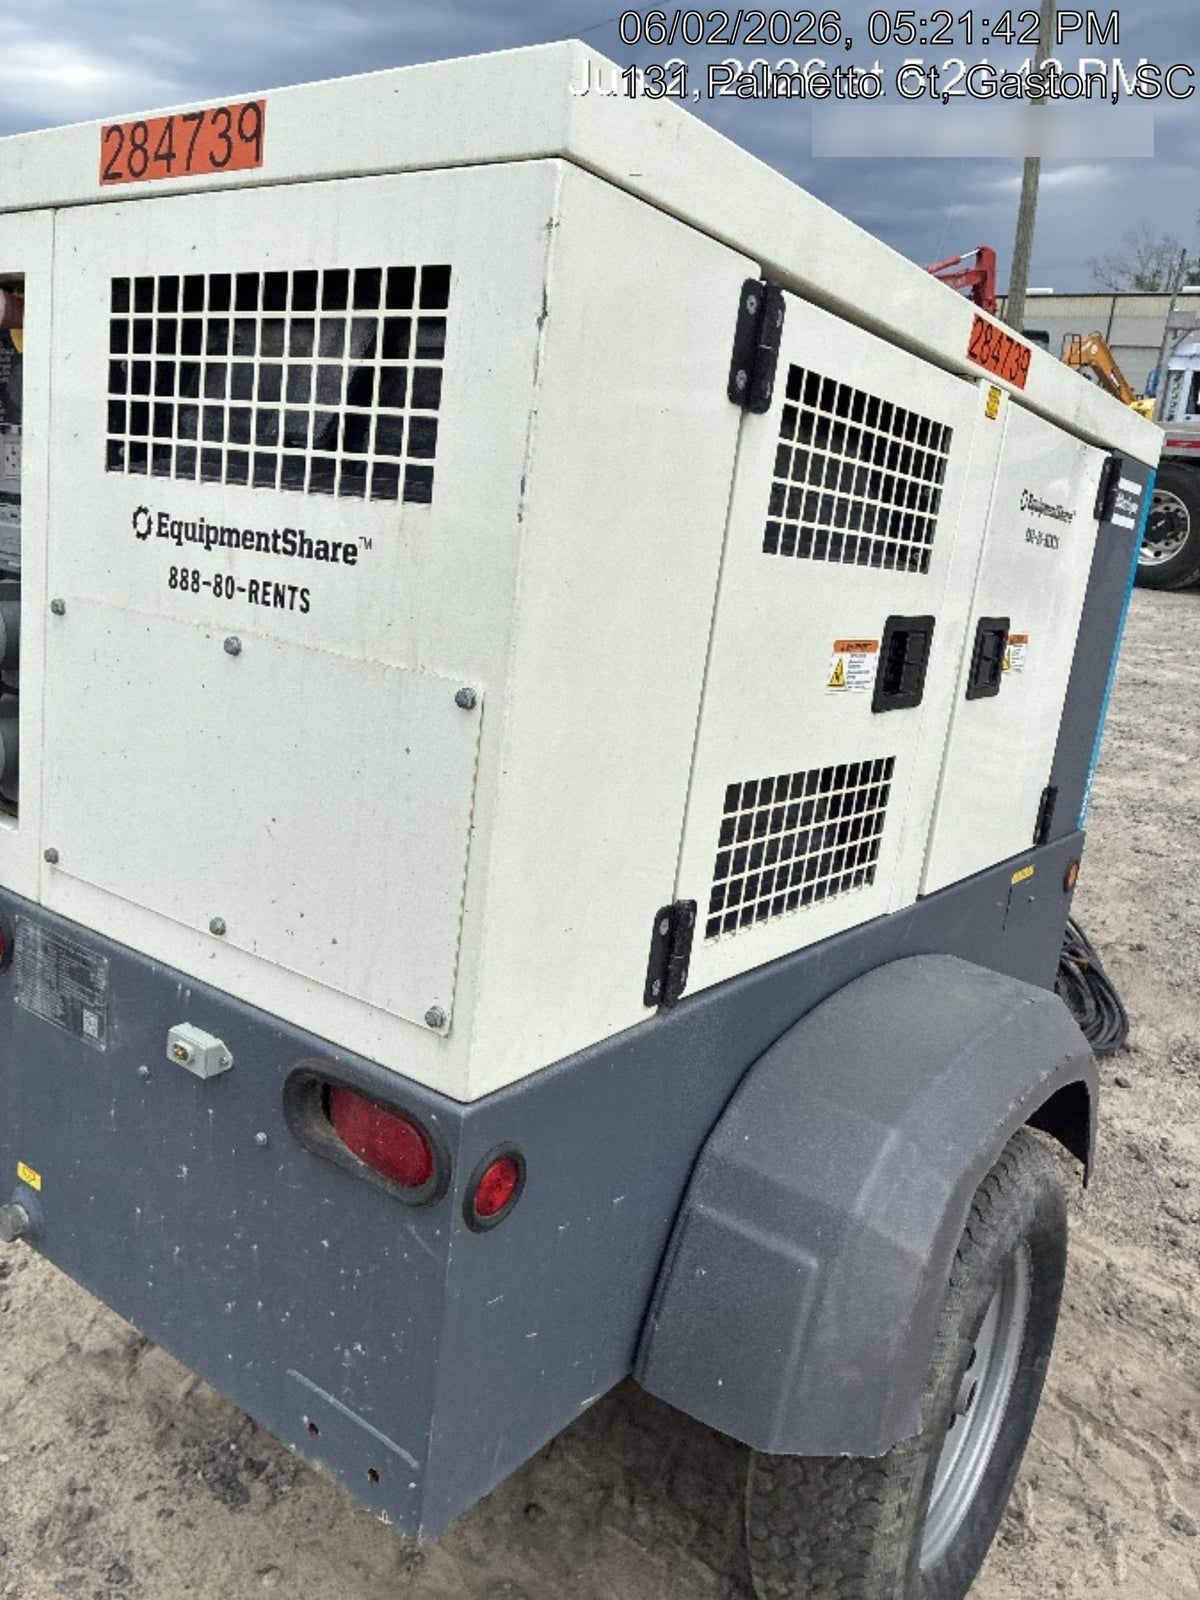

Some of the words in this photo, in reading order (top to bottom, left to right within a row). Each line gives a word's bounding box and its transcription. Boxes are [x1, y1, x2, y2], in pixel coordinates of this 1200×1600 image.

[102, 101, 263, 180] 284739
[968, 316, 1032, 390] 284739
[168, 565, 311, 614] 888-80-RENTS
